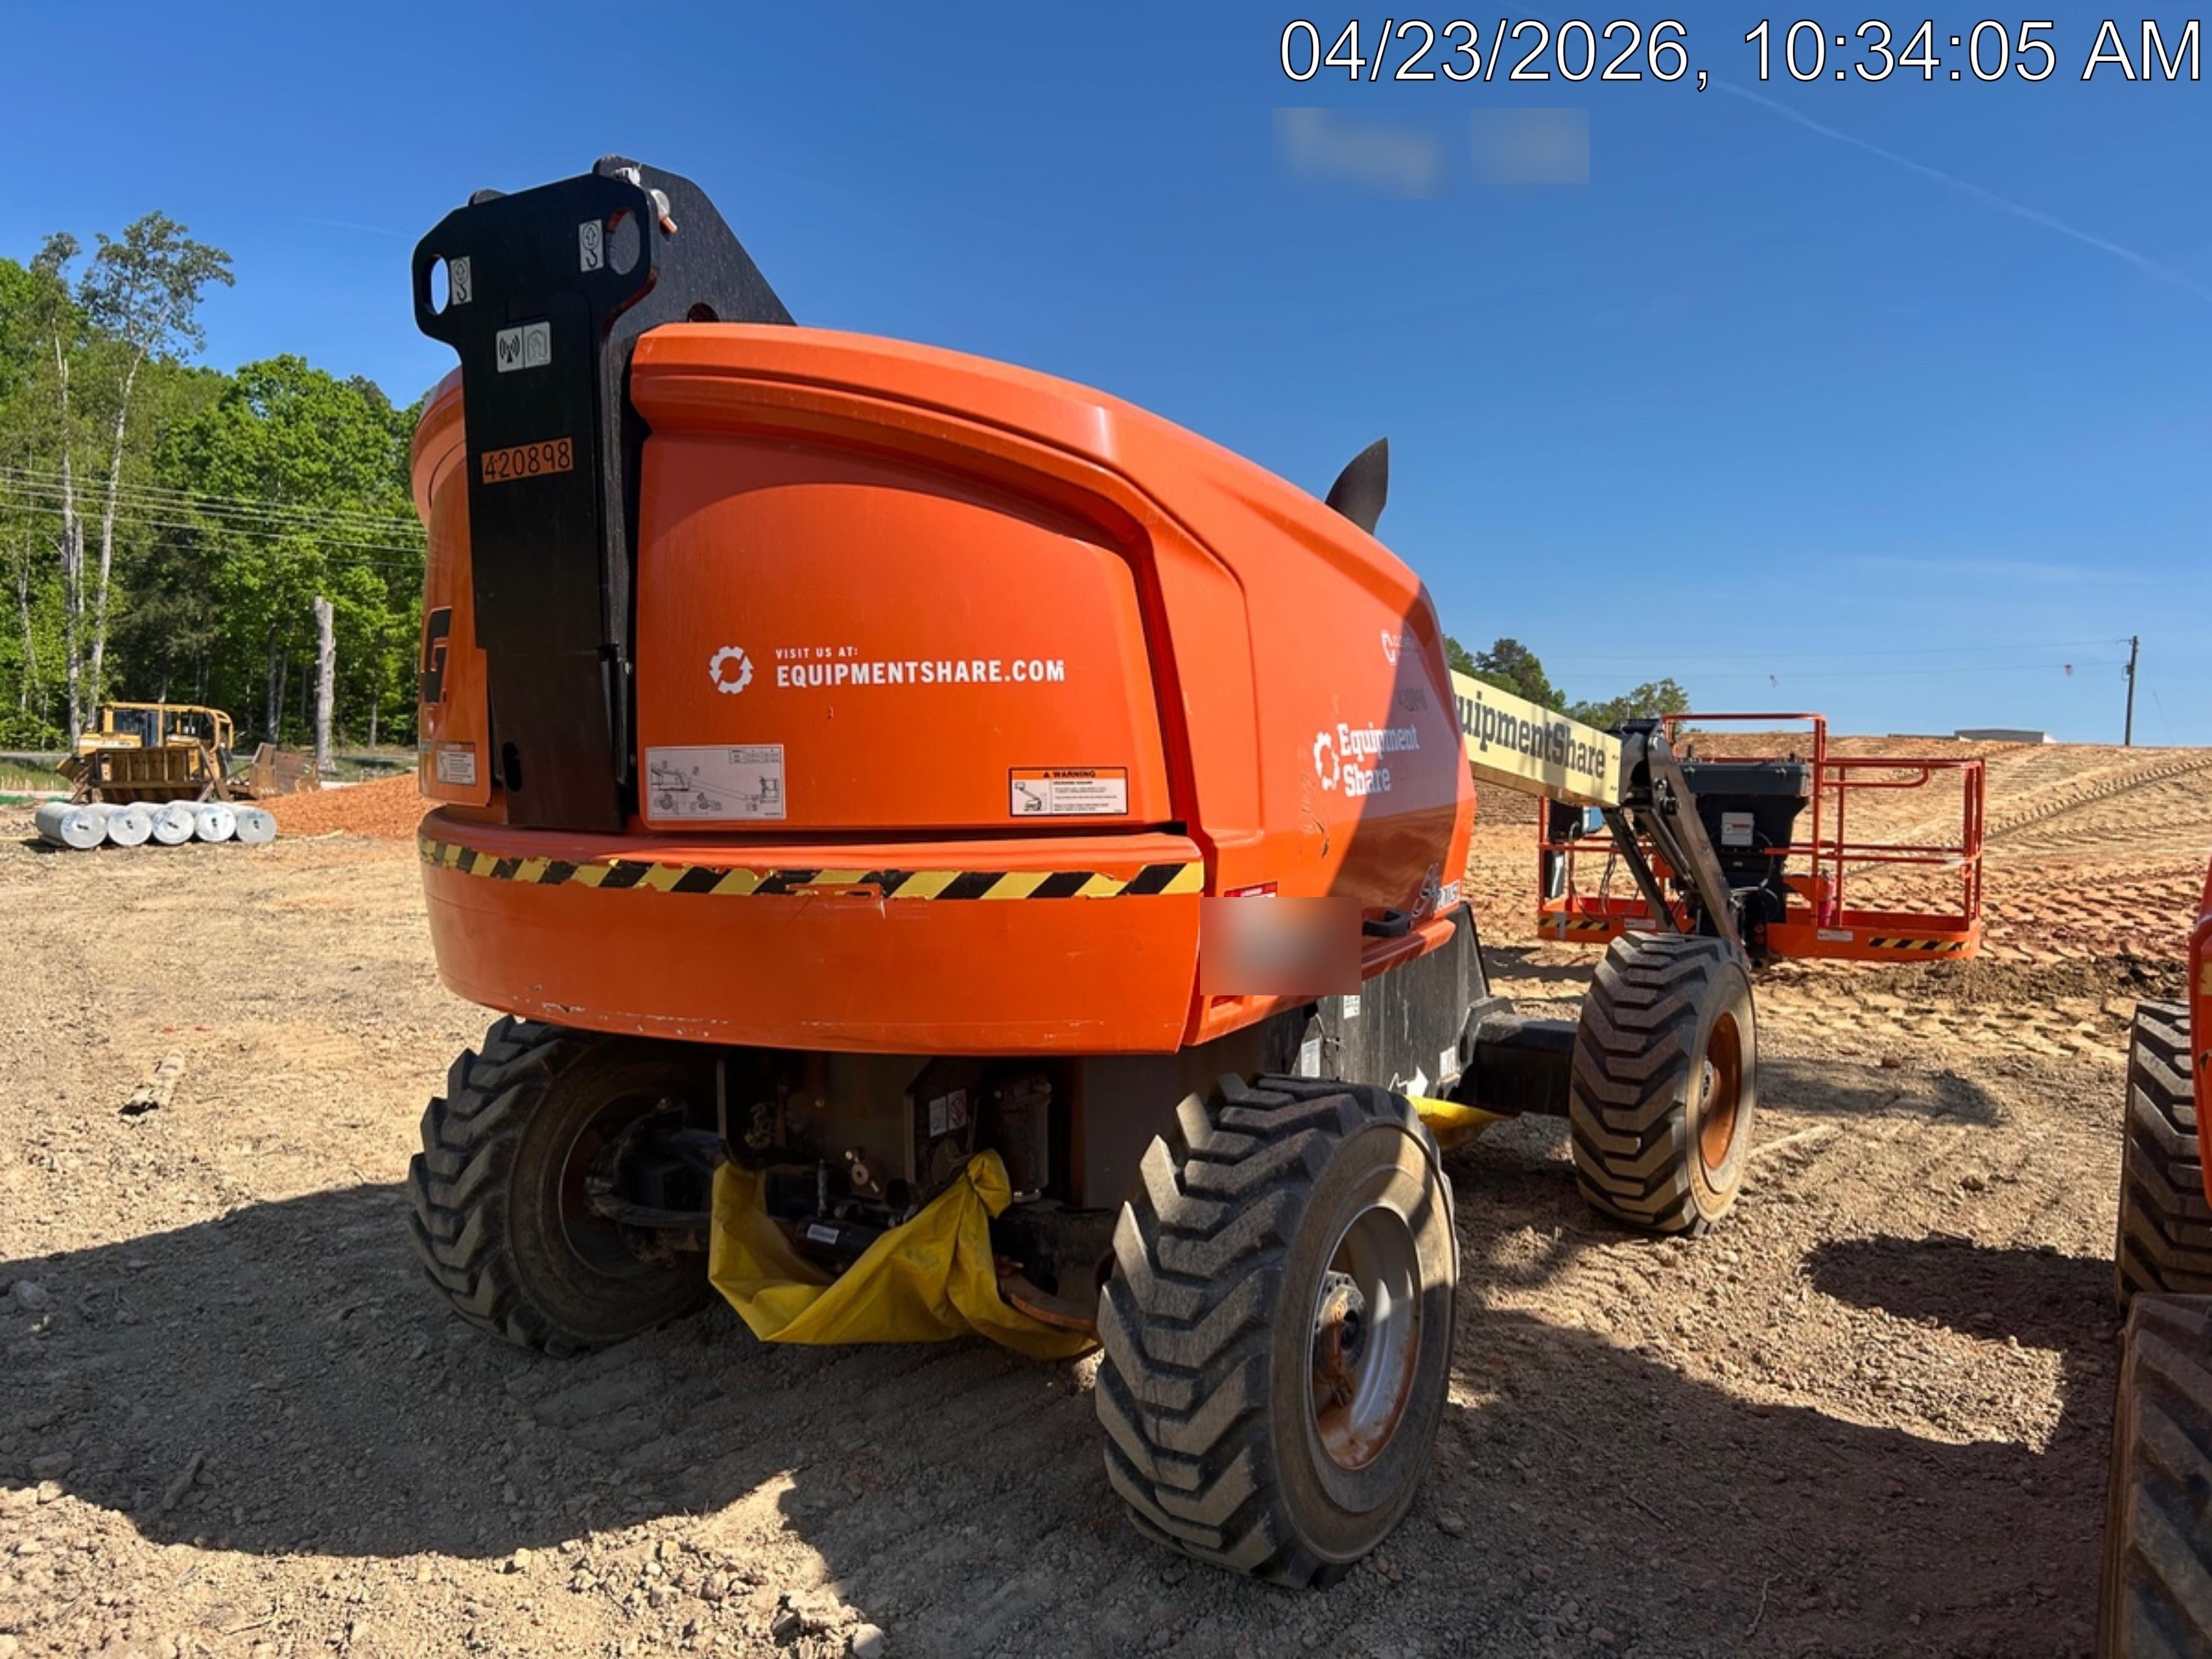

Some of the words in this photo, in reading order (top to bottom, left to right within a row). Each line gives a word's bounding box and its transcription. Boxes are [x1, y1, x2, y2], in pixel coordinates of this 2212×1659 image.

[485, 441, 570, 480] 420898
[775, 648, 810, 659] VISIT
[816, 647, 832, 658] US
[838, 646, 858, 657] AT:
[777, 659, 1065, 688] EQUIPMENTSHARE.COM
[1337, 722, 1420, 763] Equipment
[1454, 691, 1606, 779] uipmentShare
[1343, 763, 1391, 797] Share
